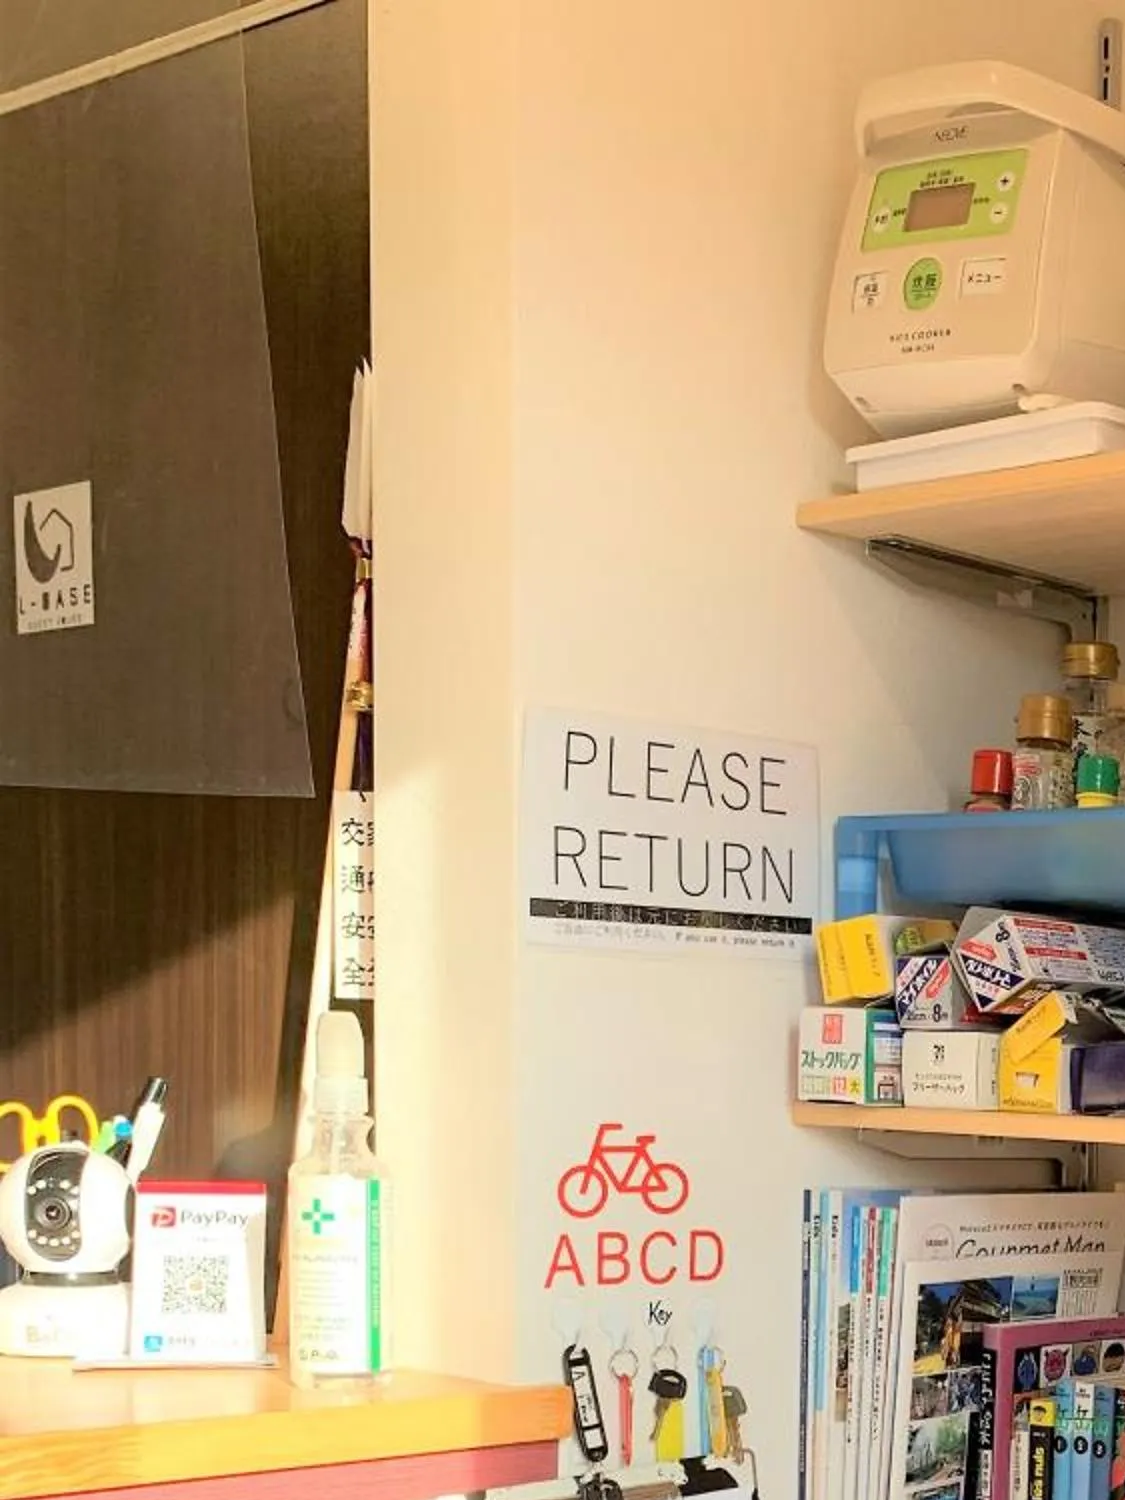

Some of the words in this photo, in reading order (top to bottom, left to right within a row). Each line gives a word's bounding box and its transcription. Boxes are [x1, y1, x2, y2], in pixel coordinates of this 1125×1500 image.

[967, 272, 1002, 284] メニュー
[564, 730, 787, 816] PLEASE
[553, 825, 793, 904] RETURN
[340, 817, 366, 987] 交通安全
[180, 1208, 249, 1227] PayPay
[1065, 1233, 1106, 1254] Man
[647, 1299, 673, 1325] Key
[1032, 1446, 1046, 1477] nuls
